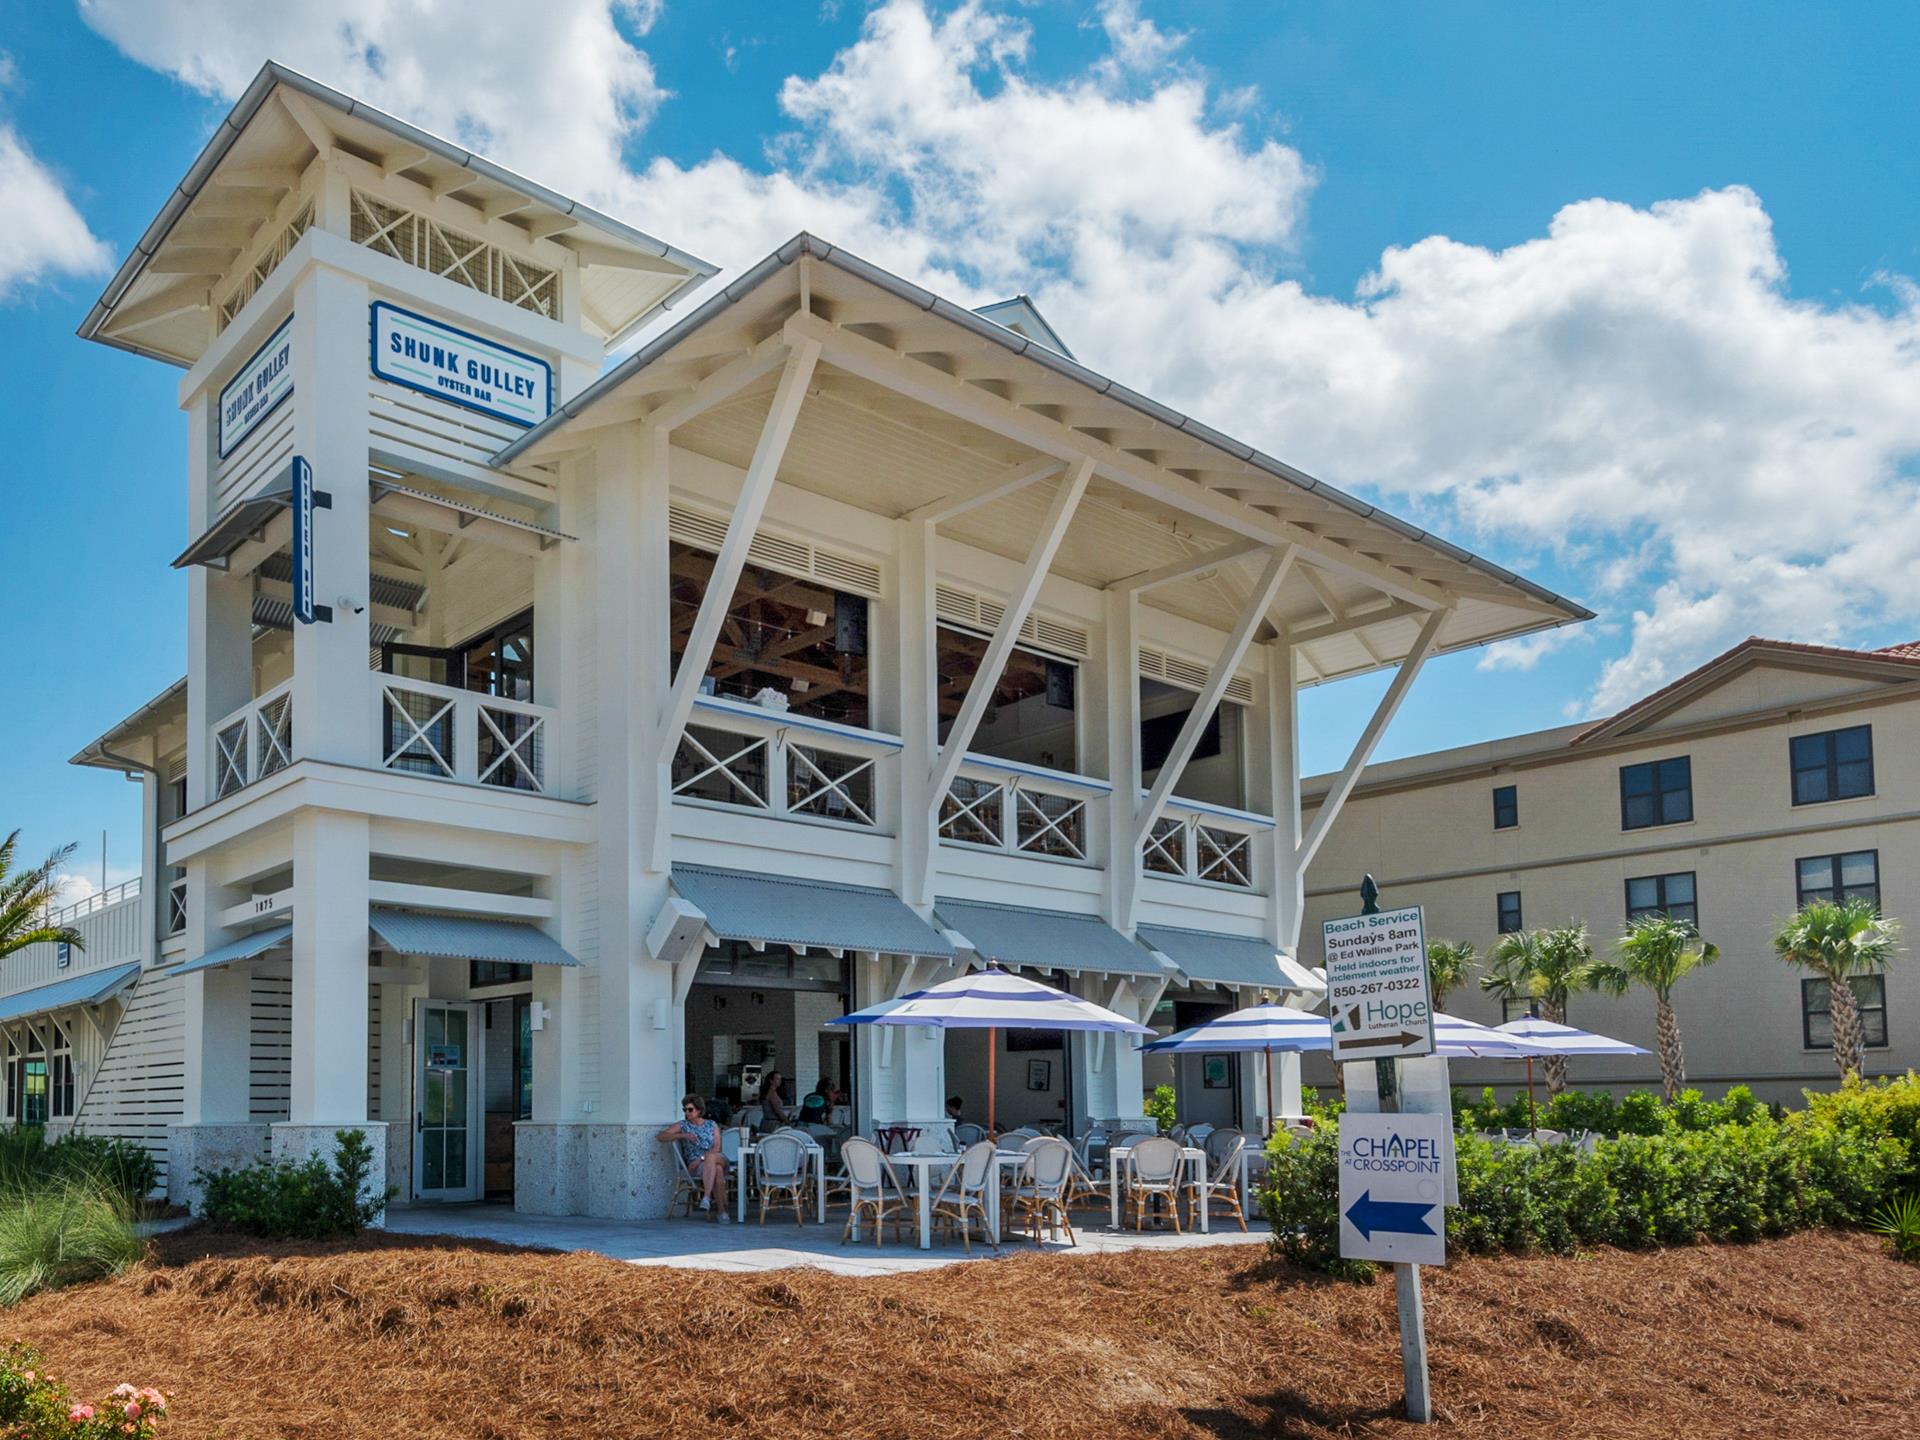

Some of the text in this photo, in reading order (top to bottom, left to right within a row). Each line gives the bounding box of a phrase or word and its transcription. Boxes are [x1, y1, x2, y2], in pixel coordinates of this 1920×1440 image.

[256, 343, 290, 394] GULLEY
[390, 332, 535, 400] SHUNK GULLEY
[438, 375, 492, 402] OYSTER BAR
[1325, 912, 1418, 934] Beach Service
[1328, 929, 1417, 949] Sundays 8am
[1328, 941, 1419, 962] @ Ed Walline Park
[1328, 965, 1422, 983] inclement weather.
[1334, 955, 1415, 972] Held indoors for
[1333, 978, 1420, 998] 850-267-0322
[1367, 1000, 1427, 1024] Hope
[1368, 1018, 1428, 1030] Lutheran Church
[1353, 1133, 1440, 1160] CHAPEL
[1353, 1159, 1440, 1174] CROSSPOINT
